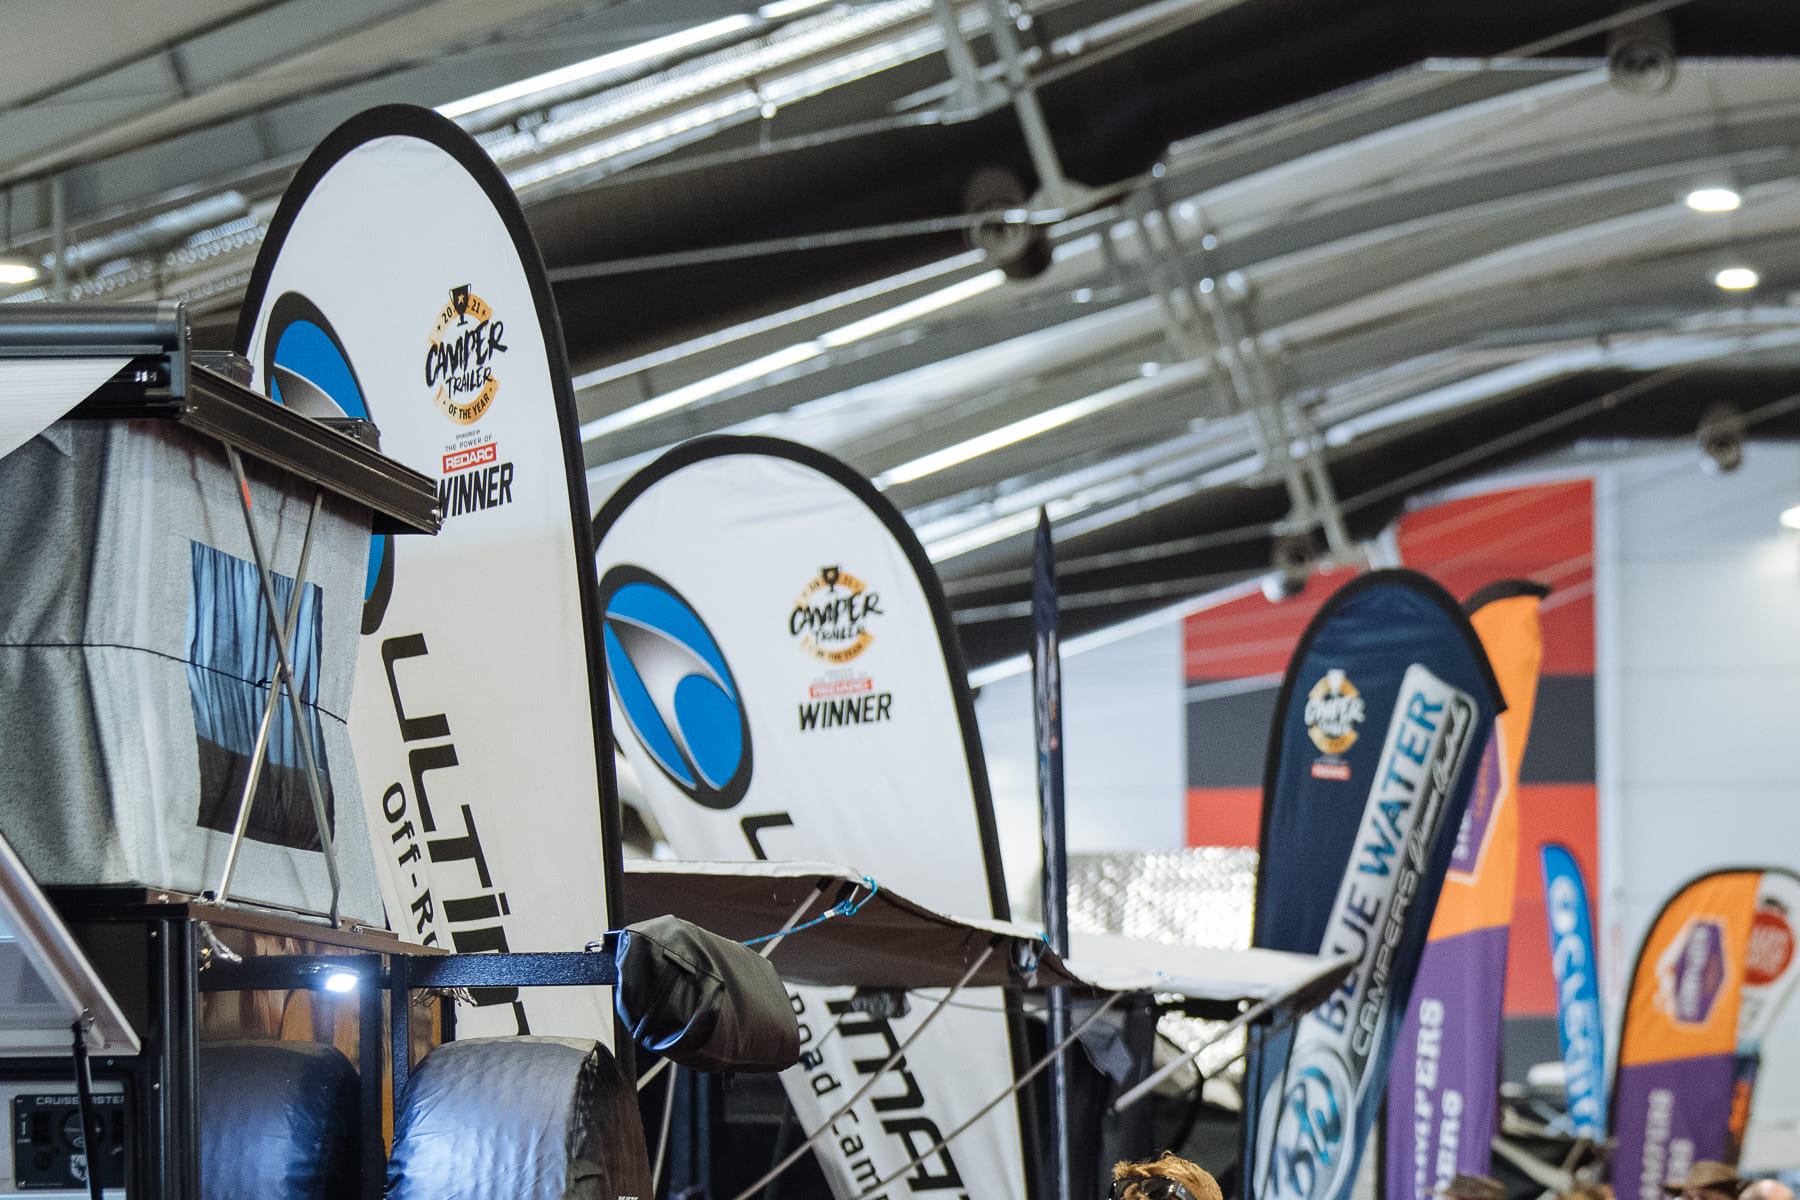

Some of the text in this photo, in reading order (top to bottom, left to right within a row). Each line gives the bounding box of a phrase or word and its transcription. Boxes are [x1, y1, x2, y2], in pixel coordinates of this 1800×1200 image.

[442, 299, 481, 324] 20 21
[425, 319, 508, 388] CAMPER
[446, 367, 493, 399] TRAILER
[448, 392, 490, 420] OF THE YEAR
[445, 434, 493, 452] THE POWER OF
[445, 446, 494, 470] REDARC
[433, 462, 513, 519] WINNER
[789, 592, 883, 636] CAMPER
[798, 691, 892, 731] WINNER
[1359, 690, 1443, 878] WATER
[1352, 868, 1418, 1058] CAMPERS
